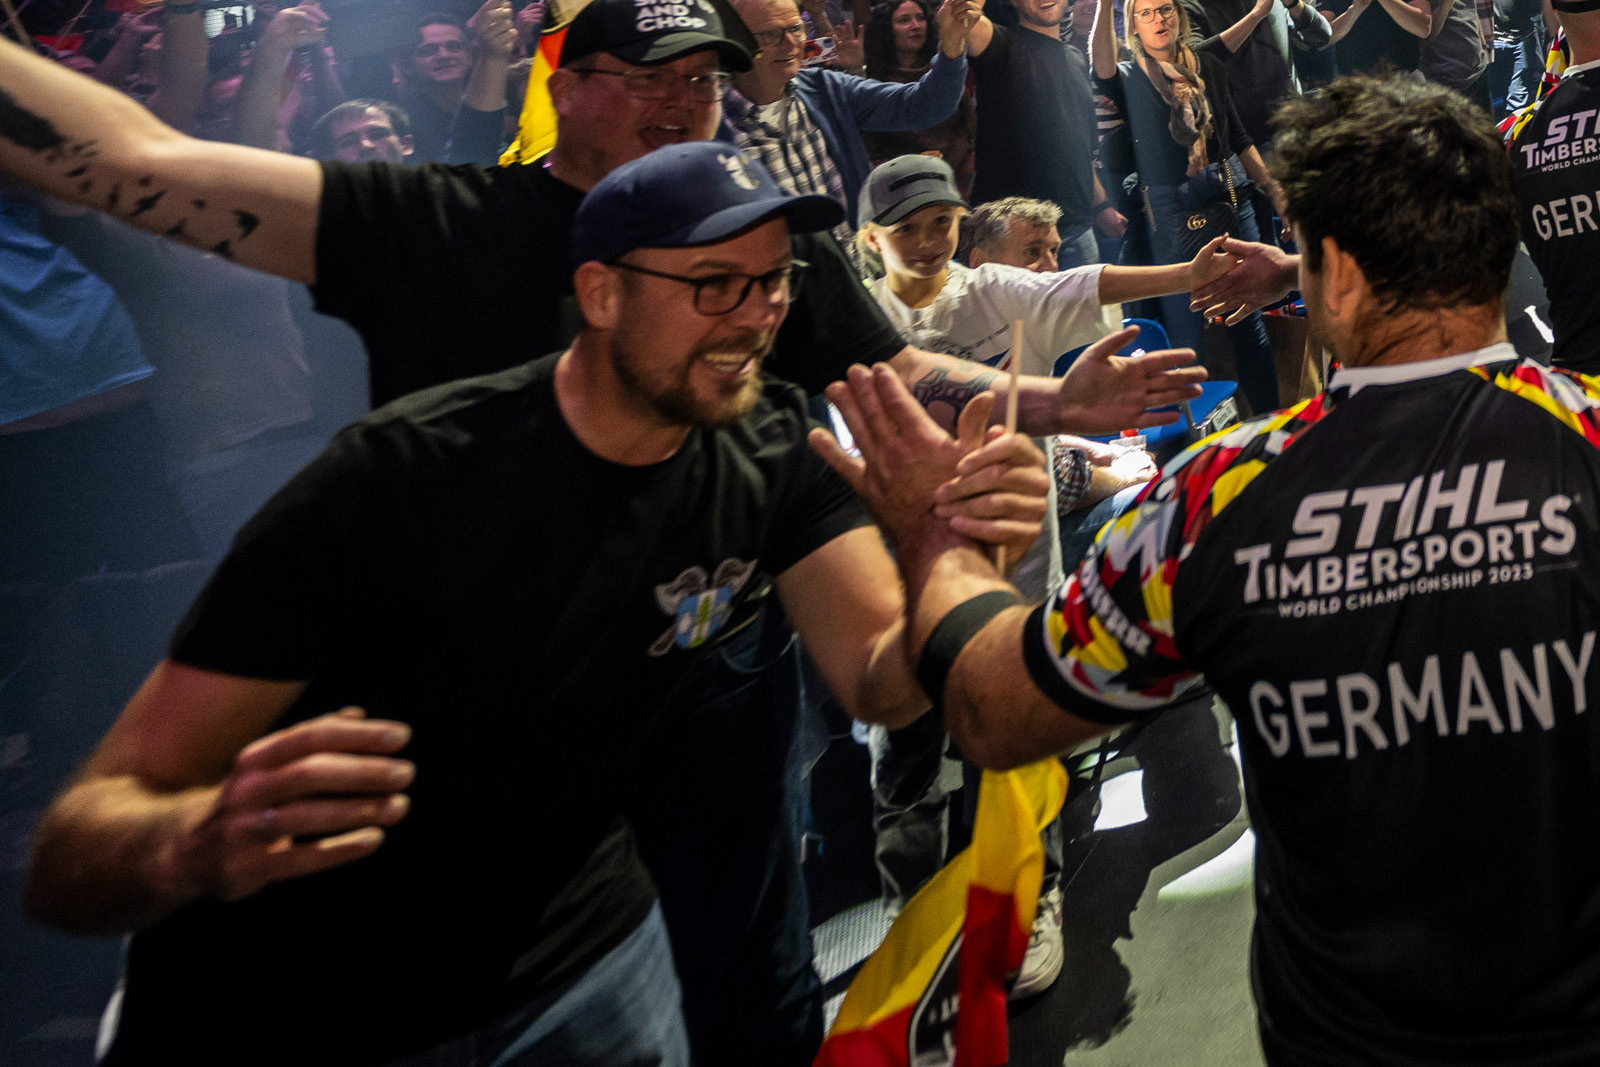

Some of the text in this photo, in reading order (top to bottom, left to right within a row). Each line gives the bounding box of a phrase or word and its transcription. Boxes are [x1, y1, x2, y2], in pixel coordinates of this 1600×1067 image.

[635, 16, 708, 33] CHOP
[636, 3, 691, 21] AND
[1541, 160, 1570, 173] WORLD
[1284, 459, 1529, 558] STIHL
[1234, 494, 1577, 604] TIMBERSPORTS
[1278, 563, 1534, 619] WORLD CHAMPIONSHIP 2023
[1249, 630, 1597, 760] GERMANY
